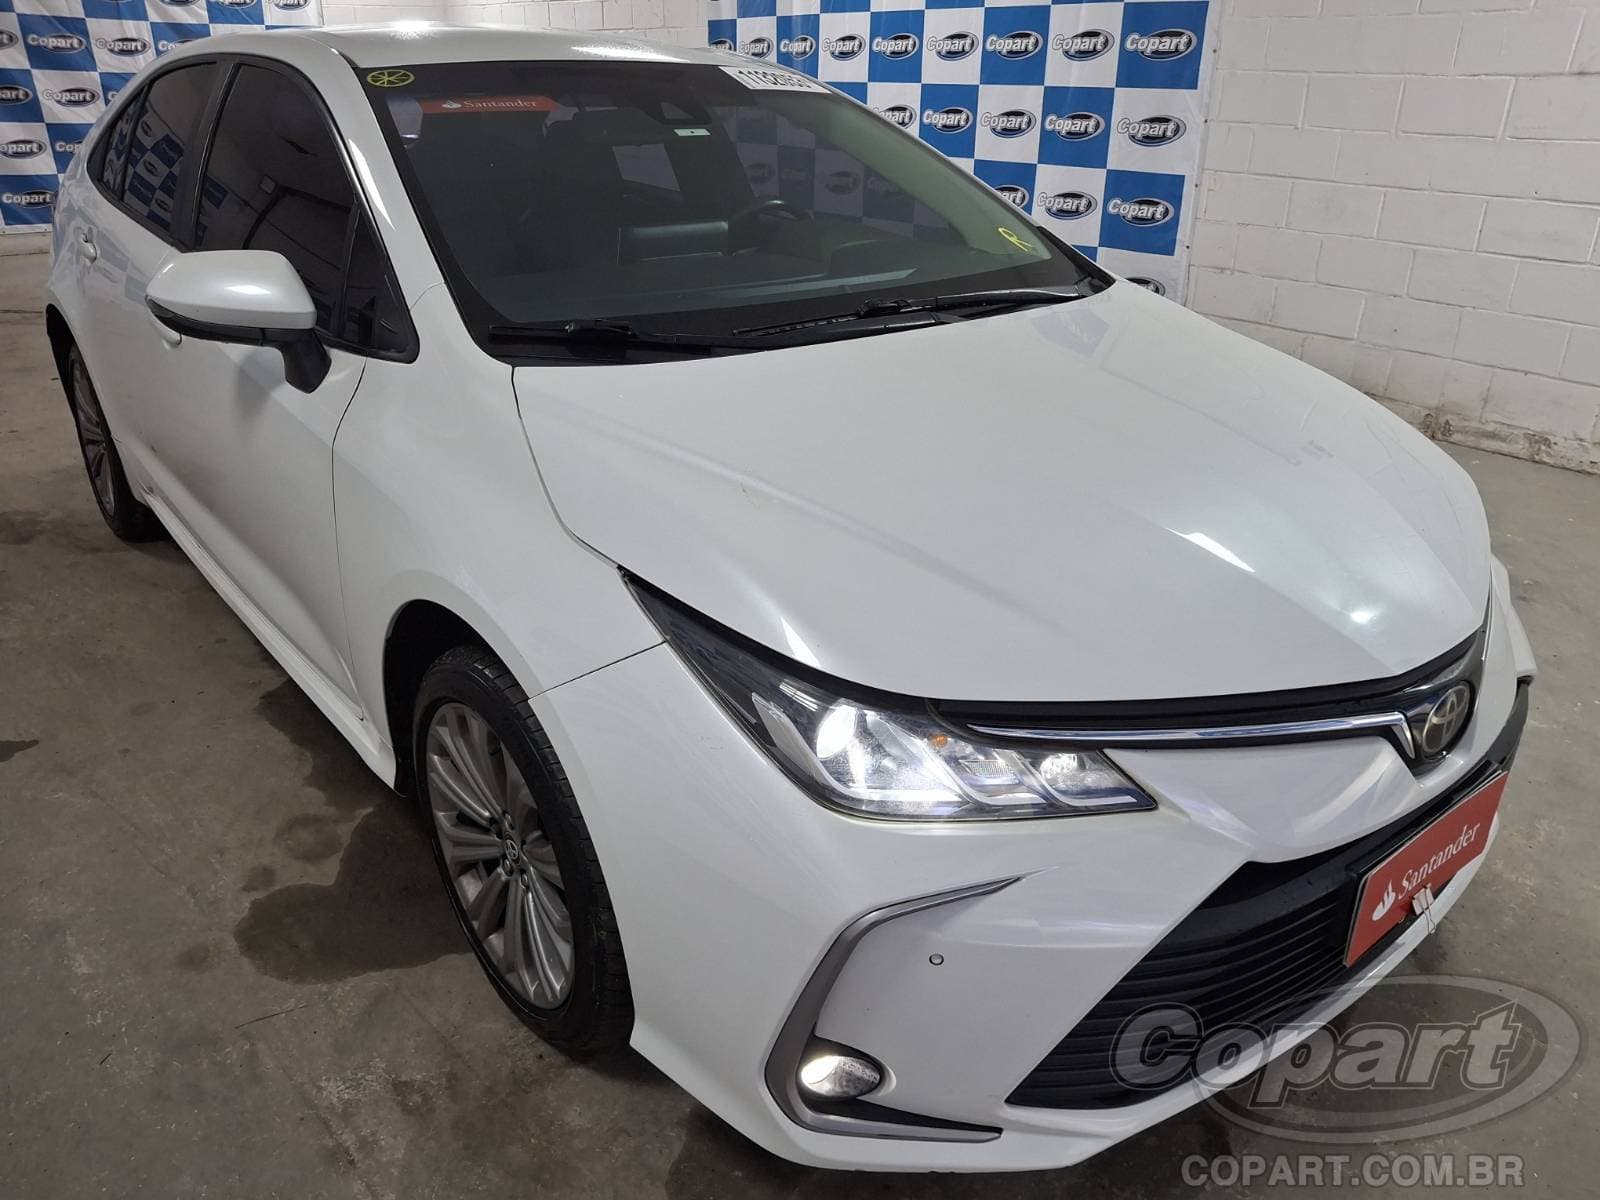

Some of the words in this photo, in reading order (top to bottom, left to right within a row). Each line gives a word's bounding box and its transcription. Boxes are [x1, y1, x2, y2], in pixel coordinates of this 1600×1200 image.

[27, 34, 80, 49] Copart
[95, 37, 144, 51] Copart
[779, 39, 811, 55] Copart
[822, 37, 861, 55] Copart
[872, 36, 914, 55] Copart
[926, 35, 972, 55] Copart
[985, 35, 1039, 56] Copart
[1052, 33, 1107, 55] Copart
[1125, 33, 1189, 55] Copart
[0, 88, 25, 99] art
[43, 89, 92, 102] Copart
[464, 98, 537, 109] Santander
[923, 109, 967, 126] Copart
[981, 112, 1030, 132] Copart
[1045, 115, 1098, 136] Copart
[1117, 118, 1178, 140] Copart
[0, 142, 40, 154] opart
[2, 192, 51, 205] Copart
[1037, 192, 1090, 213] Copart
[1108, 199, 1166, 221] Copart
[1398, 823, 1480, 899] Santander
